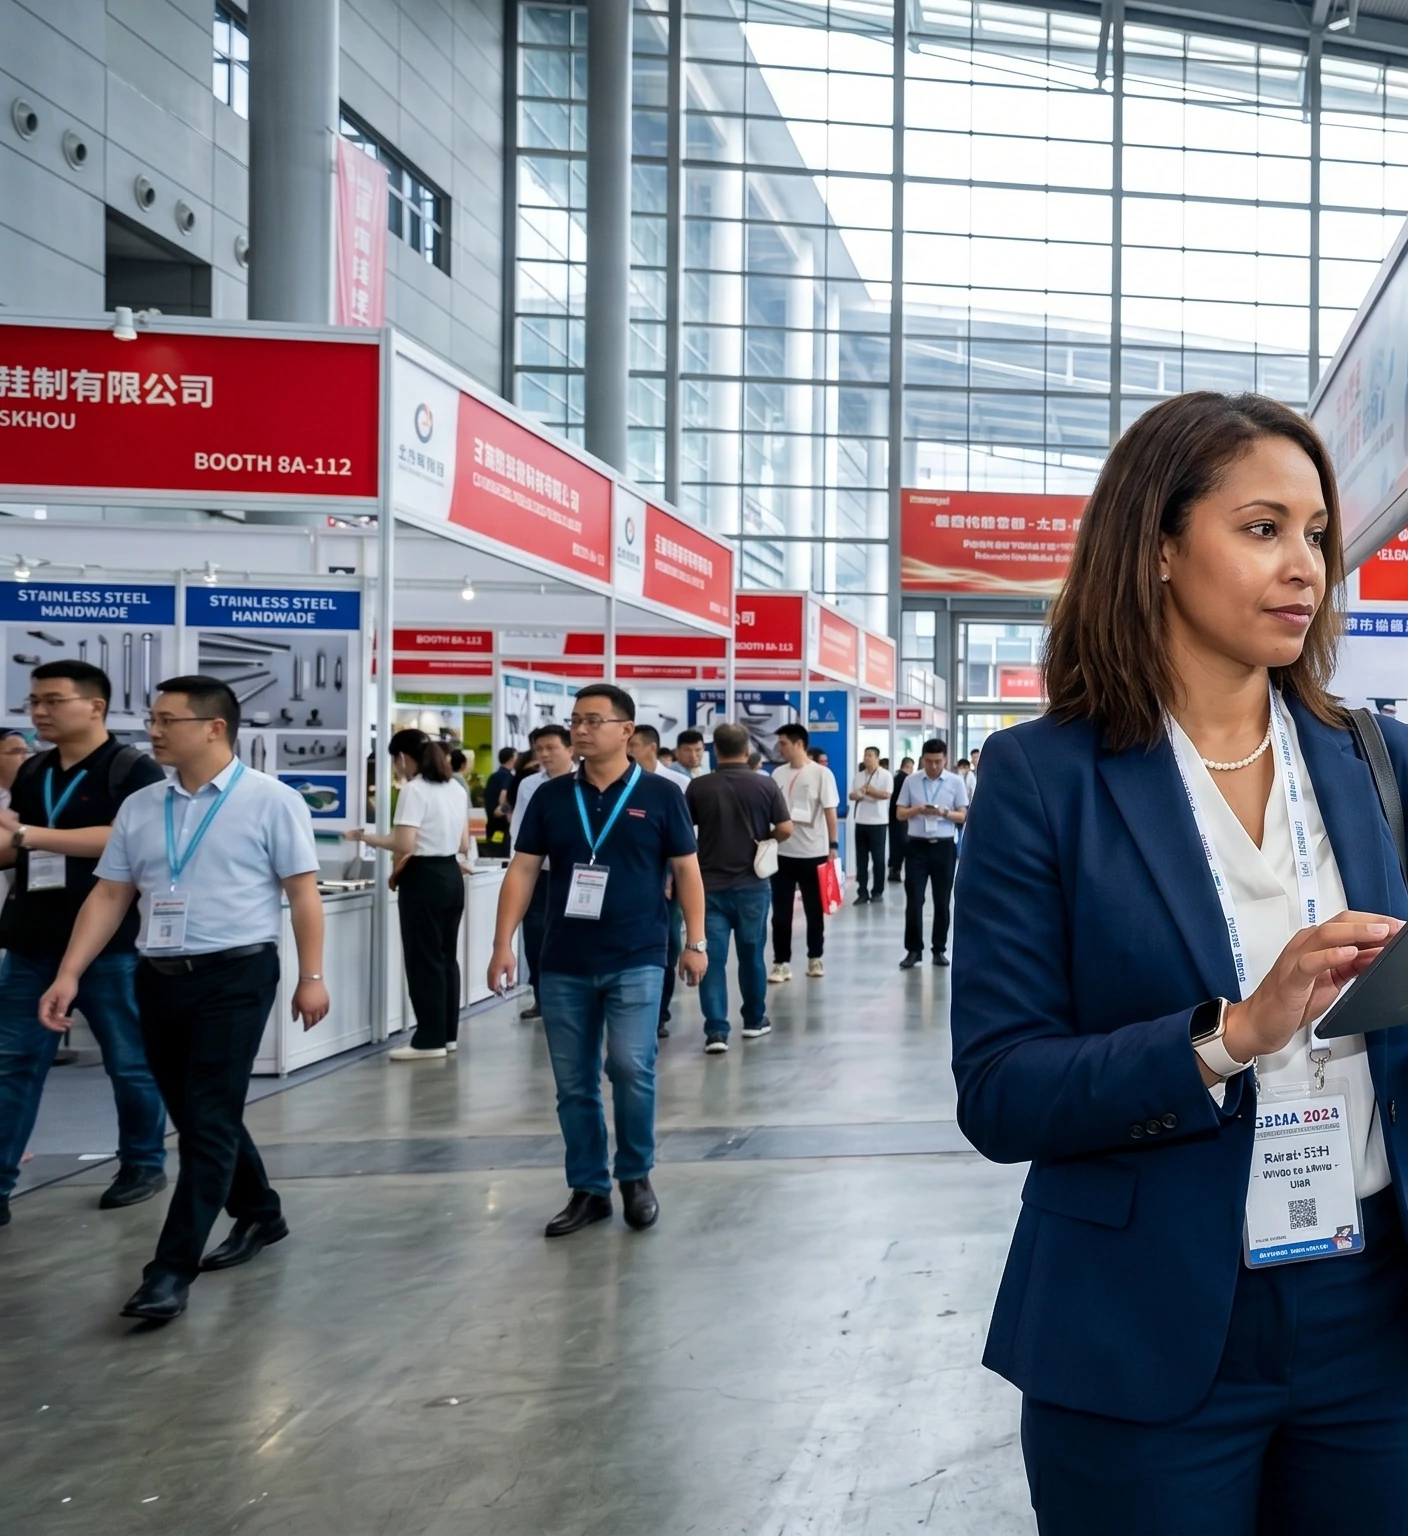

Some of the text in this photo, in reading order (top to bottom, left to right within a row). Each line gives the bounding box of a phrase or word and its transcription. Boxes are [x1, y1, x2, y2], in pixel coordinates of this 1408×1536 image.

[194, 452, 352, 476] BOOTH 8A-112
[18, 589, 151, 605] STAINLESS STEEL
[209, 594, 337, 610] STAINLESS STEEL
[232, 611, 316, 624] HANDWADE
